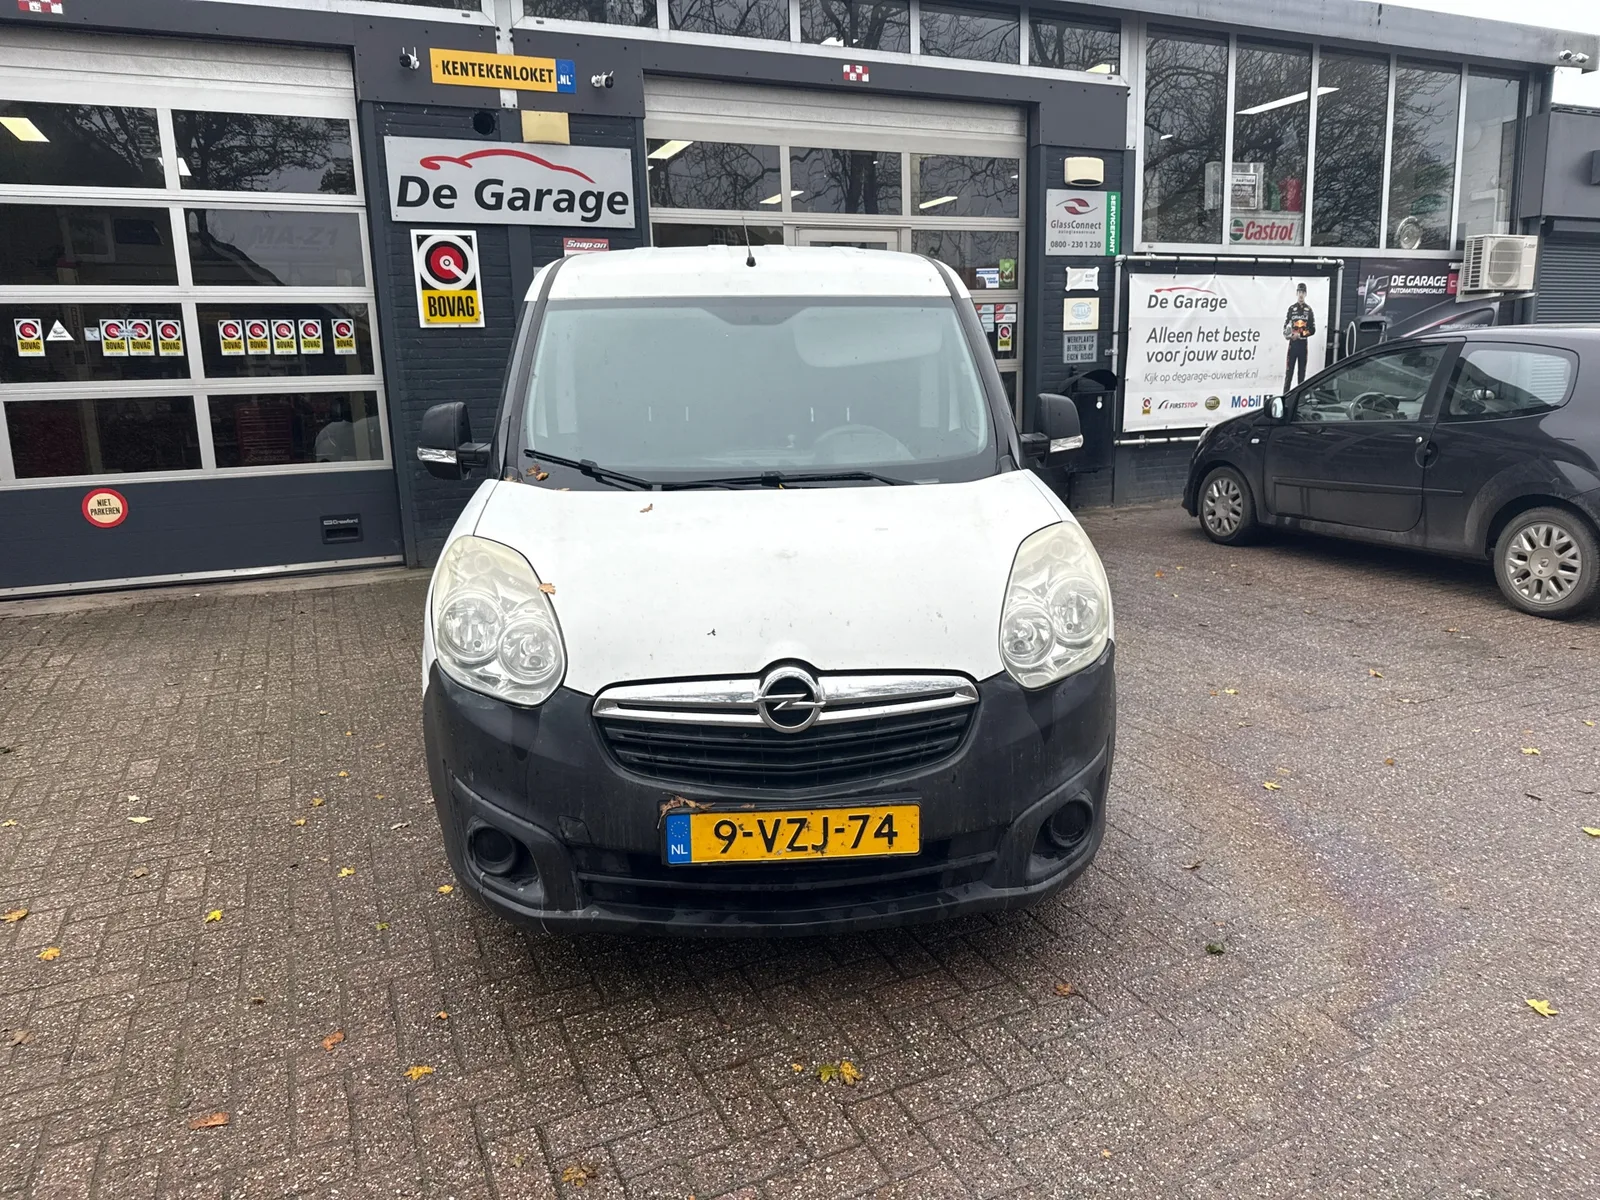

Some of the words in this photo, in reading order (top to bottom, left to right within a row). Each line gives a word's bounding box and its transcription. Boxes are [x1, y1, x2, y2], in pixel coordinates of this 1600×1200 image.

[441, 59, 554, 84] KENTEKENLOKET
[396, 175, 457, 209] De
[474, 178, 629, 223] Garage
[1050, 219, 1101, 229] GlassConnect
[1109, 194, 1117, 254] SERVICEPUNT
[1244, 220, 1294, 241] Castrol
[566, 240, 608, 250] Snap-on
[1050, 240, 1067, 248] 0800
[1089, 241, 1102, 249] 230
[1390, 275, 1406, 287] DE
[1406, 275, 1448, 287] GARAGE
[427, 295, 475, 317] BOVAG
[1147, 294, 1168, 309] De
[1173, 294, 1228, 312] Garage
[1146, 327, 1193, 343] Alleen
[1197, 326, 1221, 343] het
[1223, 326, 1261, 342] beste
[20, 341, 41, 350] BOVAG
[1146, 350, 1179, 363] voor
[1180, 346, 1218, 366] jouw
[1220, 345, 1256, 361] auto!
[1144, 372, 1159, 384] Kijk
[1160, 374, 1170, 384] op
[1171, 370, 1259, 383] degarage-ouwerkerk.nl
[1231, 395, 1261, 408] Mobil
[90, 507, 120, 515] PARKEREN
[713, 813, 898, 854] 9-VZJ-74
[671, 843, 688, 856] NL
